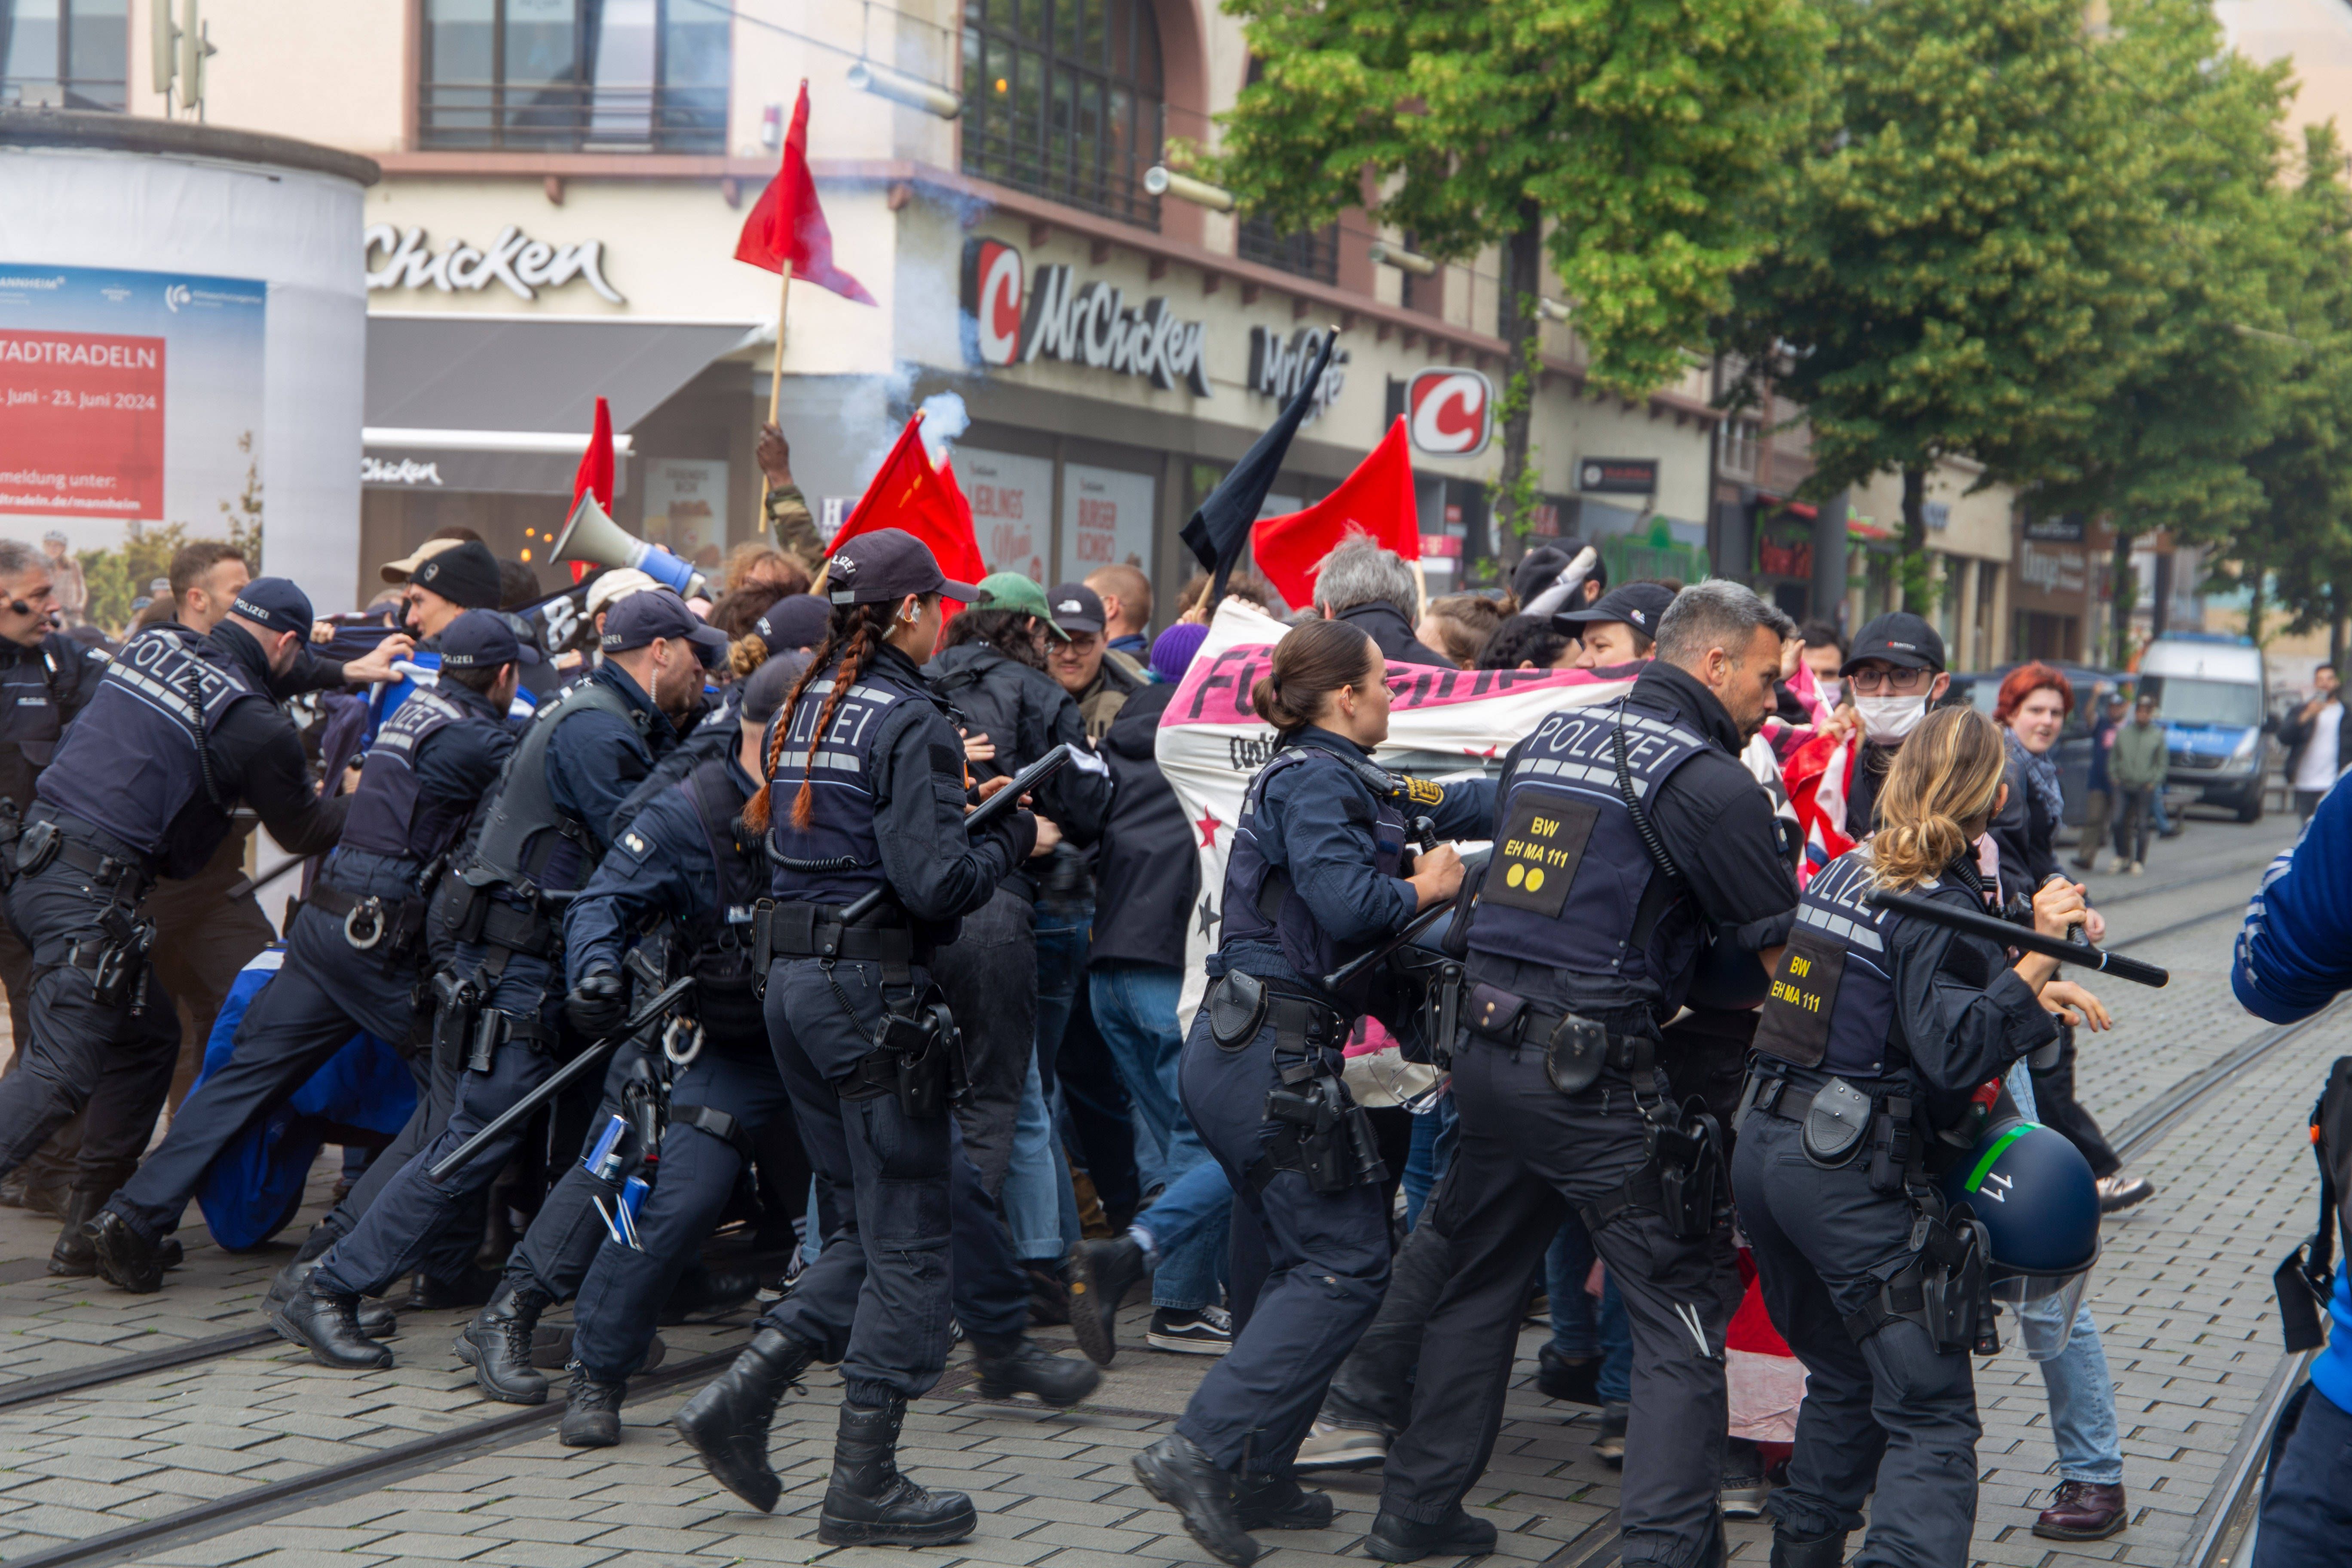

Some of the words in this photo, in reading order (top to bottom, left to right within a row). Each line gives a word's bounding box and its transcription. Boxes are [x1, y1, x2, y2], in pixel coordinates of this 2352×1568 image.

[0, 340, 156, 369] TADTRADELN
[7, 388, 38, 407] Juni
[52, 389, 75, 406] 23.
[78, 391, 110, 410] Juni
[114, 393, 156, 410] 2024
[0, 469, 66, 490] meldung
[69, 474, 117, 489] unter:
[832, 554, 856, 575] LIZEI
[235, 597, 270, 620] POLIZEI
[386, 701, 442, 735] LIZEI
[1528, 717, 1679, 773] POLIZEI
[1531, 816, 1560, 837] BW
[1504, 839, 1525, 857] EH
[1523, 842, 1544, 862] MA
[1547, 848, 1568, 868] 111
[1789, 956, 1812, 977] BW
[1771, 980, 1786, 998] EH
[1783, 984, 1800, 1005] MA
[1803, 992, 1821, 1013] 111
